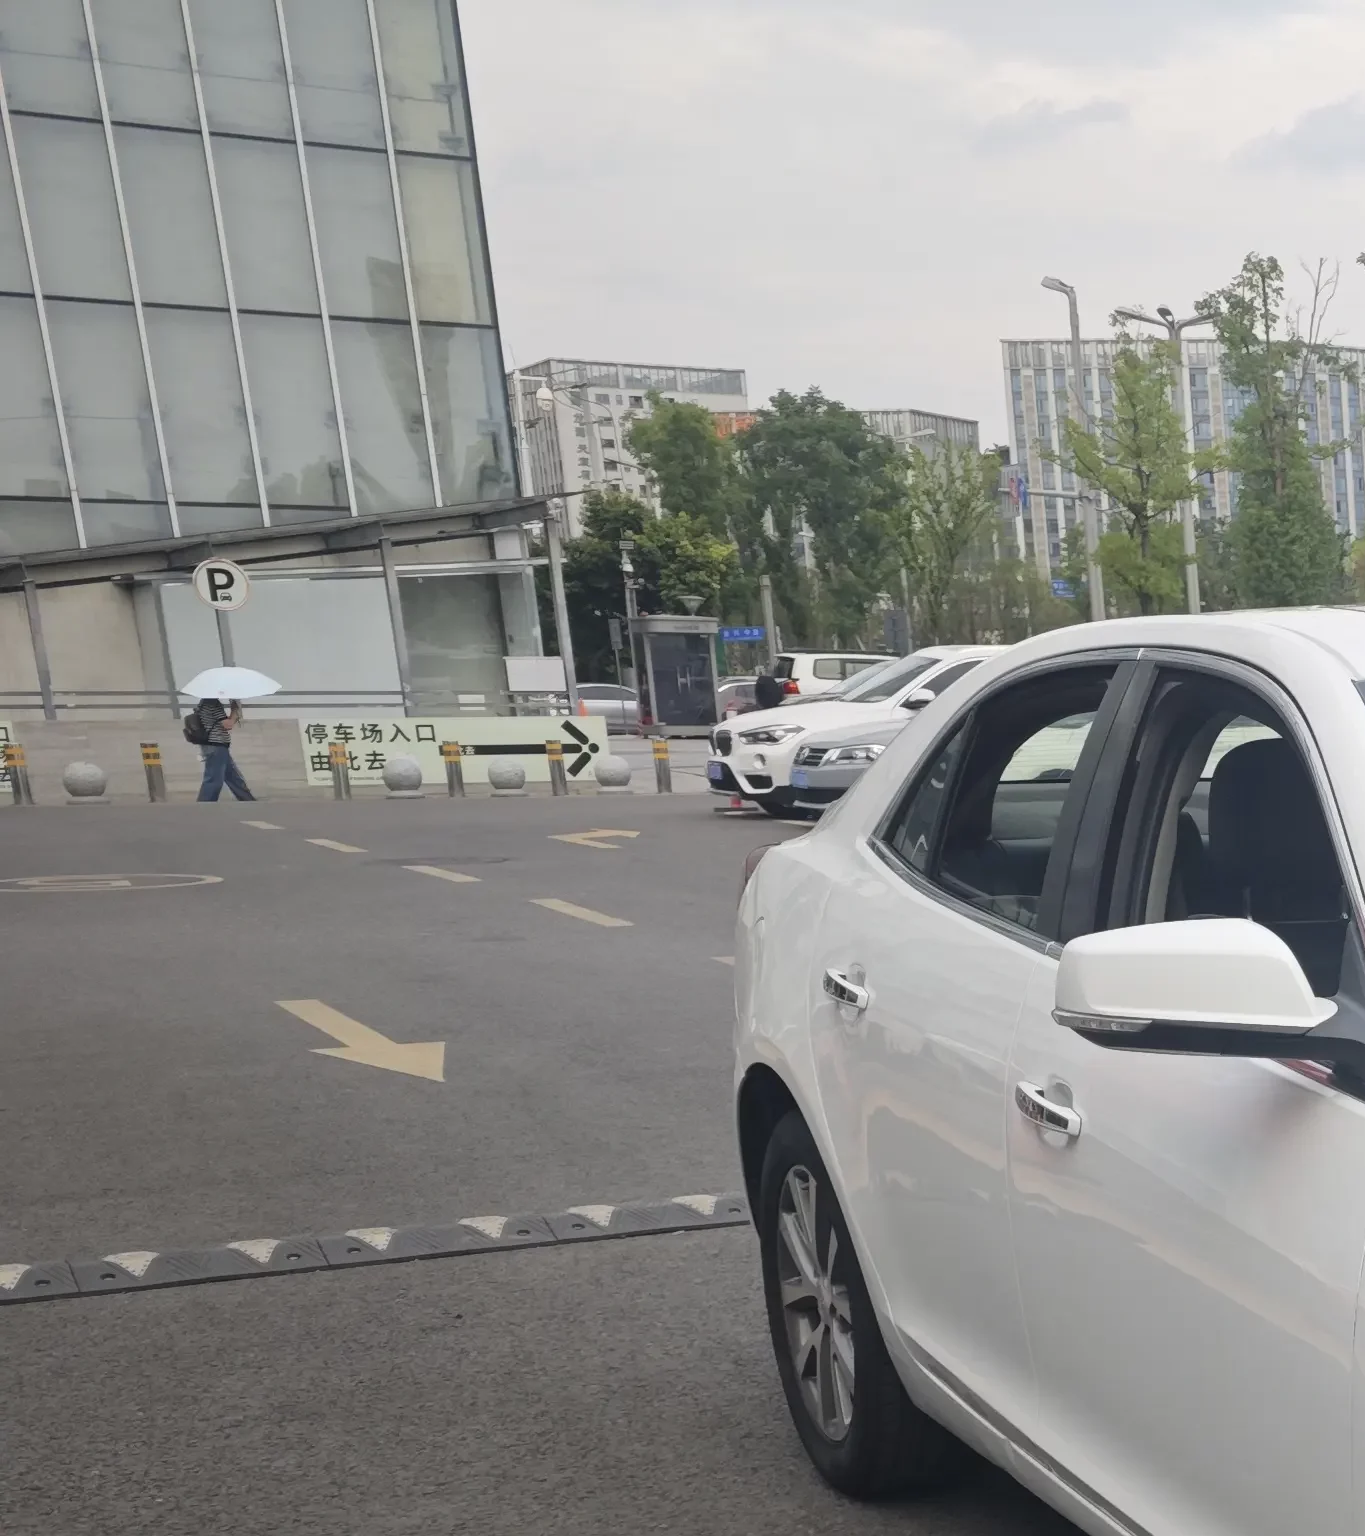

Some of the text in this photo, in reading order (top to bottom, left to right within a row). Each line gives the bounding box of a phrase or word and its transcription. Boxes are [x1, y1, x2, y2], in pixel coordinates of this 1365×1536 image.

[206, 568, 235, 602] P
[304, 722, 437, 744] 停车场入口
